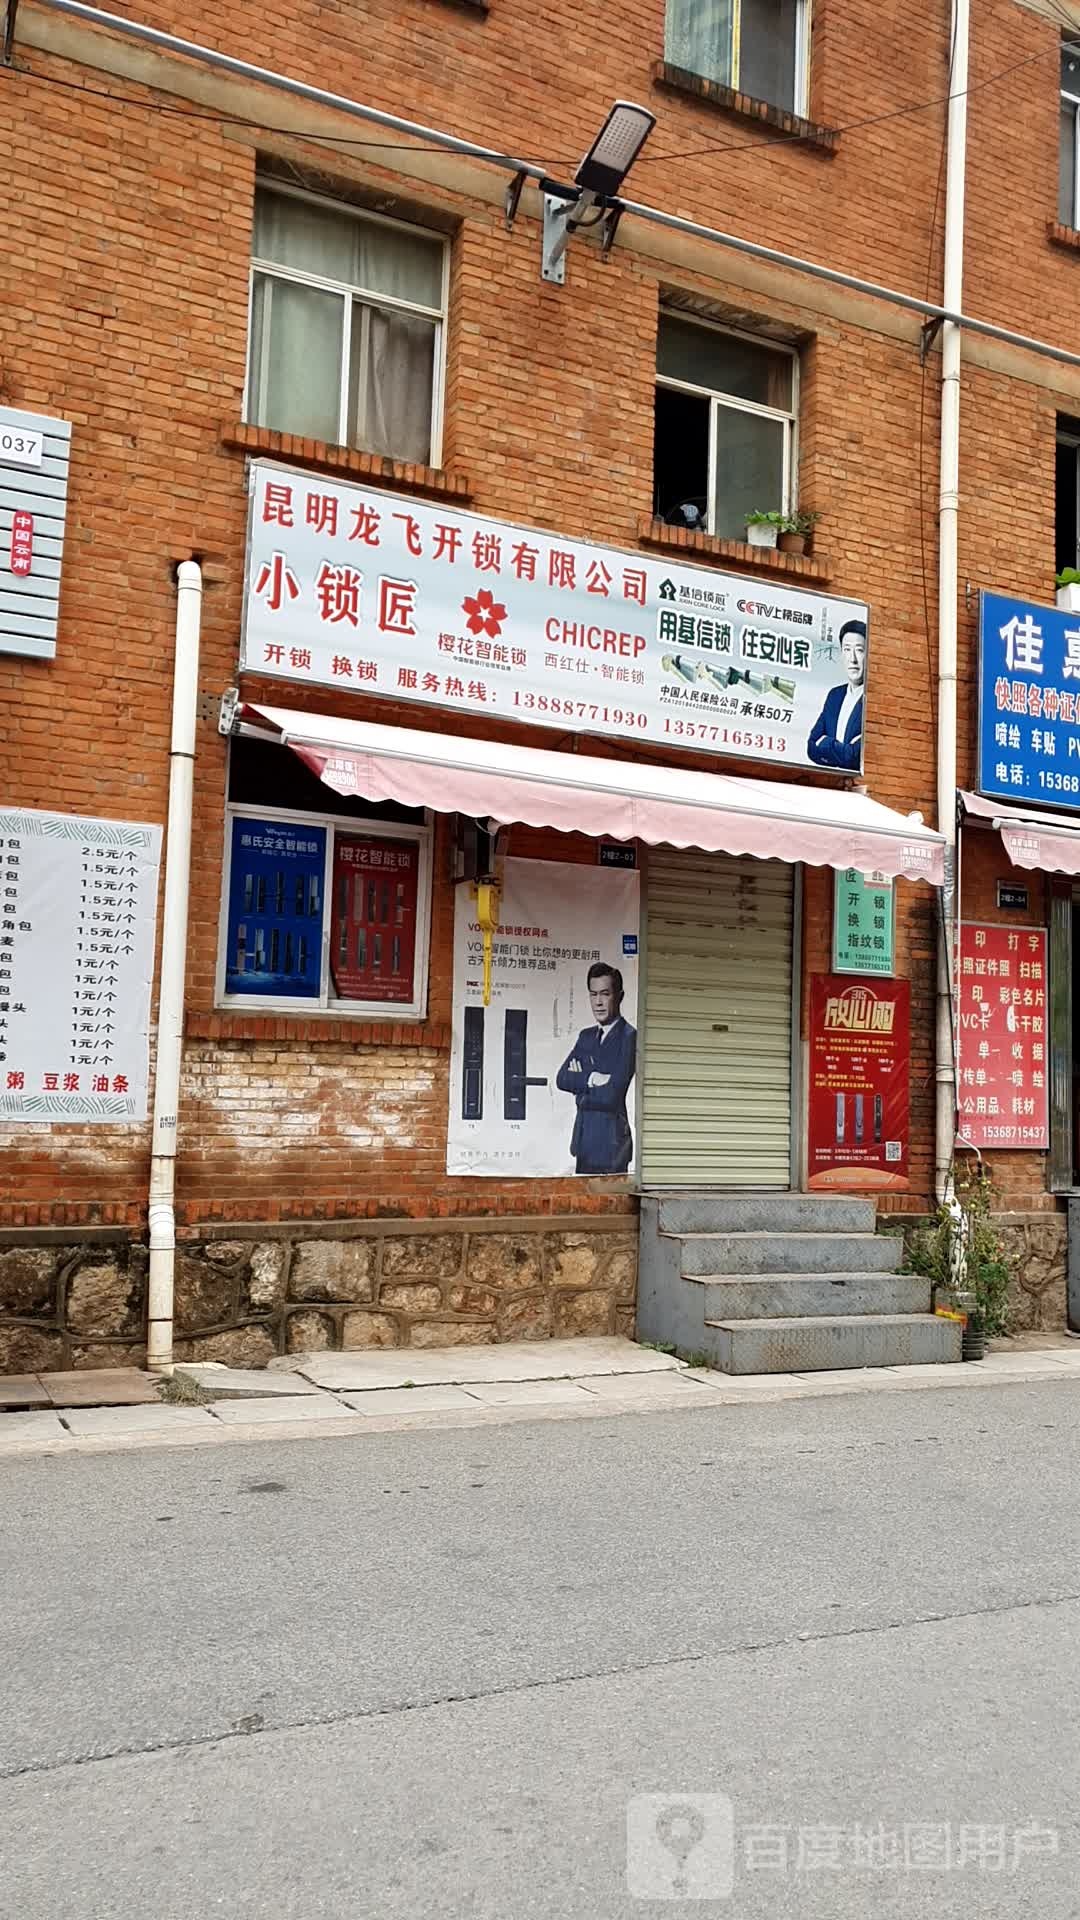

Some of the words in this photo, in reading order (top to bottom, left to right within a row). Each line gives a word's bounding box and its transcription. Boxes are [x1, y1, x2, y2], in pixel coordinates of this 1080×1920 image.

[2, 434, 37, 454] 037
[261, 481, 648, 606] 昆明龙飞开锁有限公司
[255, 555, 418, 638] 小锁匠
[544, 616, 647, 658] CHICREP
[659, 609, 732, 654] 用基信锁
[741, 627, 812, 669] 住安心家
[437, 632, 528, 668] 樱花智能锁
[263, 643, 312, 670] 开锁
[331, 655, 378, 682] 换锁
[511, 690, 649, 730] 13888771930
[663, 717, 788, 753] 13577165313
[660, 684, 740, 710] 中国人民保险公司
[994, 676, 1080, 725] 快照各种证
[739, 700, 795, 724] 承保50万
[994, 722, 1021, 750] 喷绘
[1031, 727, 1056, 756] 车贴
[81, 846, 138, 861] 2.5元/个
[81, 863, 139, 877] 1.5元/个
[81, 879, 139, 893] 1.5元/个
[80, 895, 137, 908] 1.5元/个
[79, 910, 137, 924] 1.5元/个
[77, 926, 135, 939] 1.5元/个
[77, 942, 135, 956] 1.5元/个
[847, 933, 885, 950] 指纹锁
[75, 958, 120, 971] 1元/个
[1019, 960, 1043, 980] 扫描
[74, 974, 119, 987] 1元/个
[73, 990, 118, 1002] 1元/个
[999, 985, 1046, 1008] 彩色名片
[72, 1006, 116, 1018] 1元/个
[72, 1022, 116, 1034] 1元/个
[71, 1039, 115, 1050] 1元/个
[69, 1054, 114, 1066] 1元/个
[6, 1070, 25, 1091] 粥
[42, 1072, 81, 1092] 豆浆
[91, 1073, 130, 1094] 油条
[982, 1125, 1046, 1140] 15368715437
